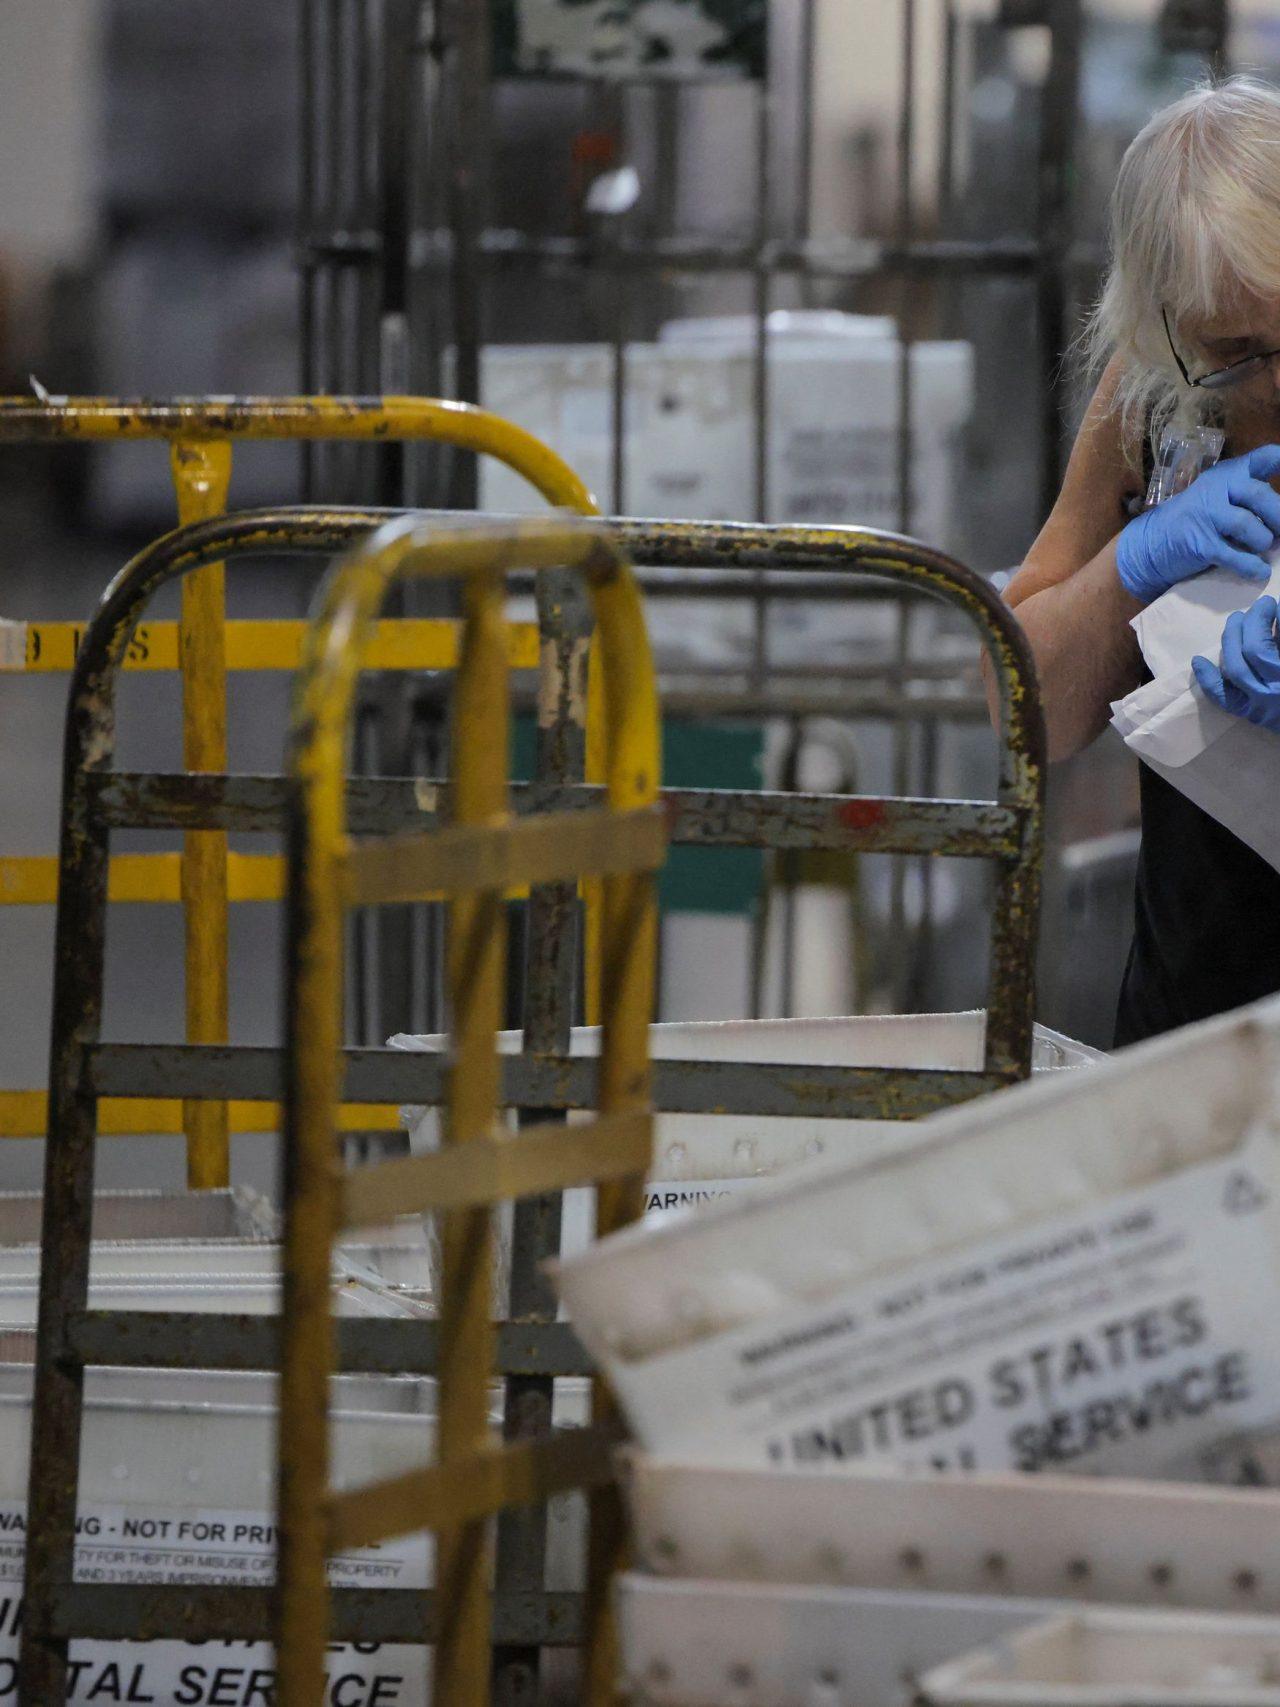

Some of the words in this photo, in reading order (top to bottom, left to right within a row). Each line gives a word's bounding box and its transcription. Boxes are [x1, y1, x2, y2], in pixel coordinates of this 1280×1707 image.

[985, 1296, 1208, 1410] STATES
[1007, 1349, 1252, 1472] SERVICE
[122, 1520, 172, 1539] NOT
[177, 1522, 226, 1542] FOR
[174, 1665, 404, 1707] SERCE
